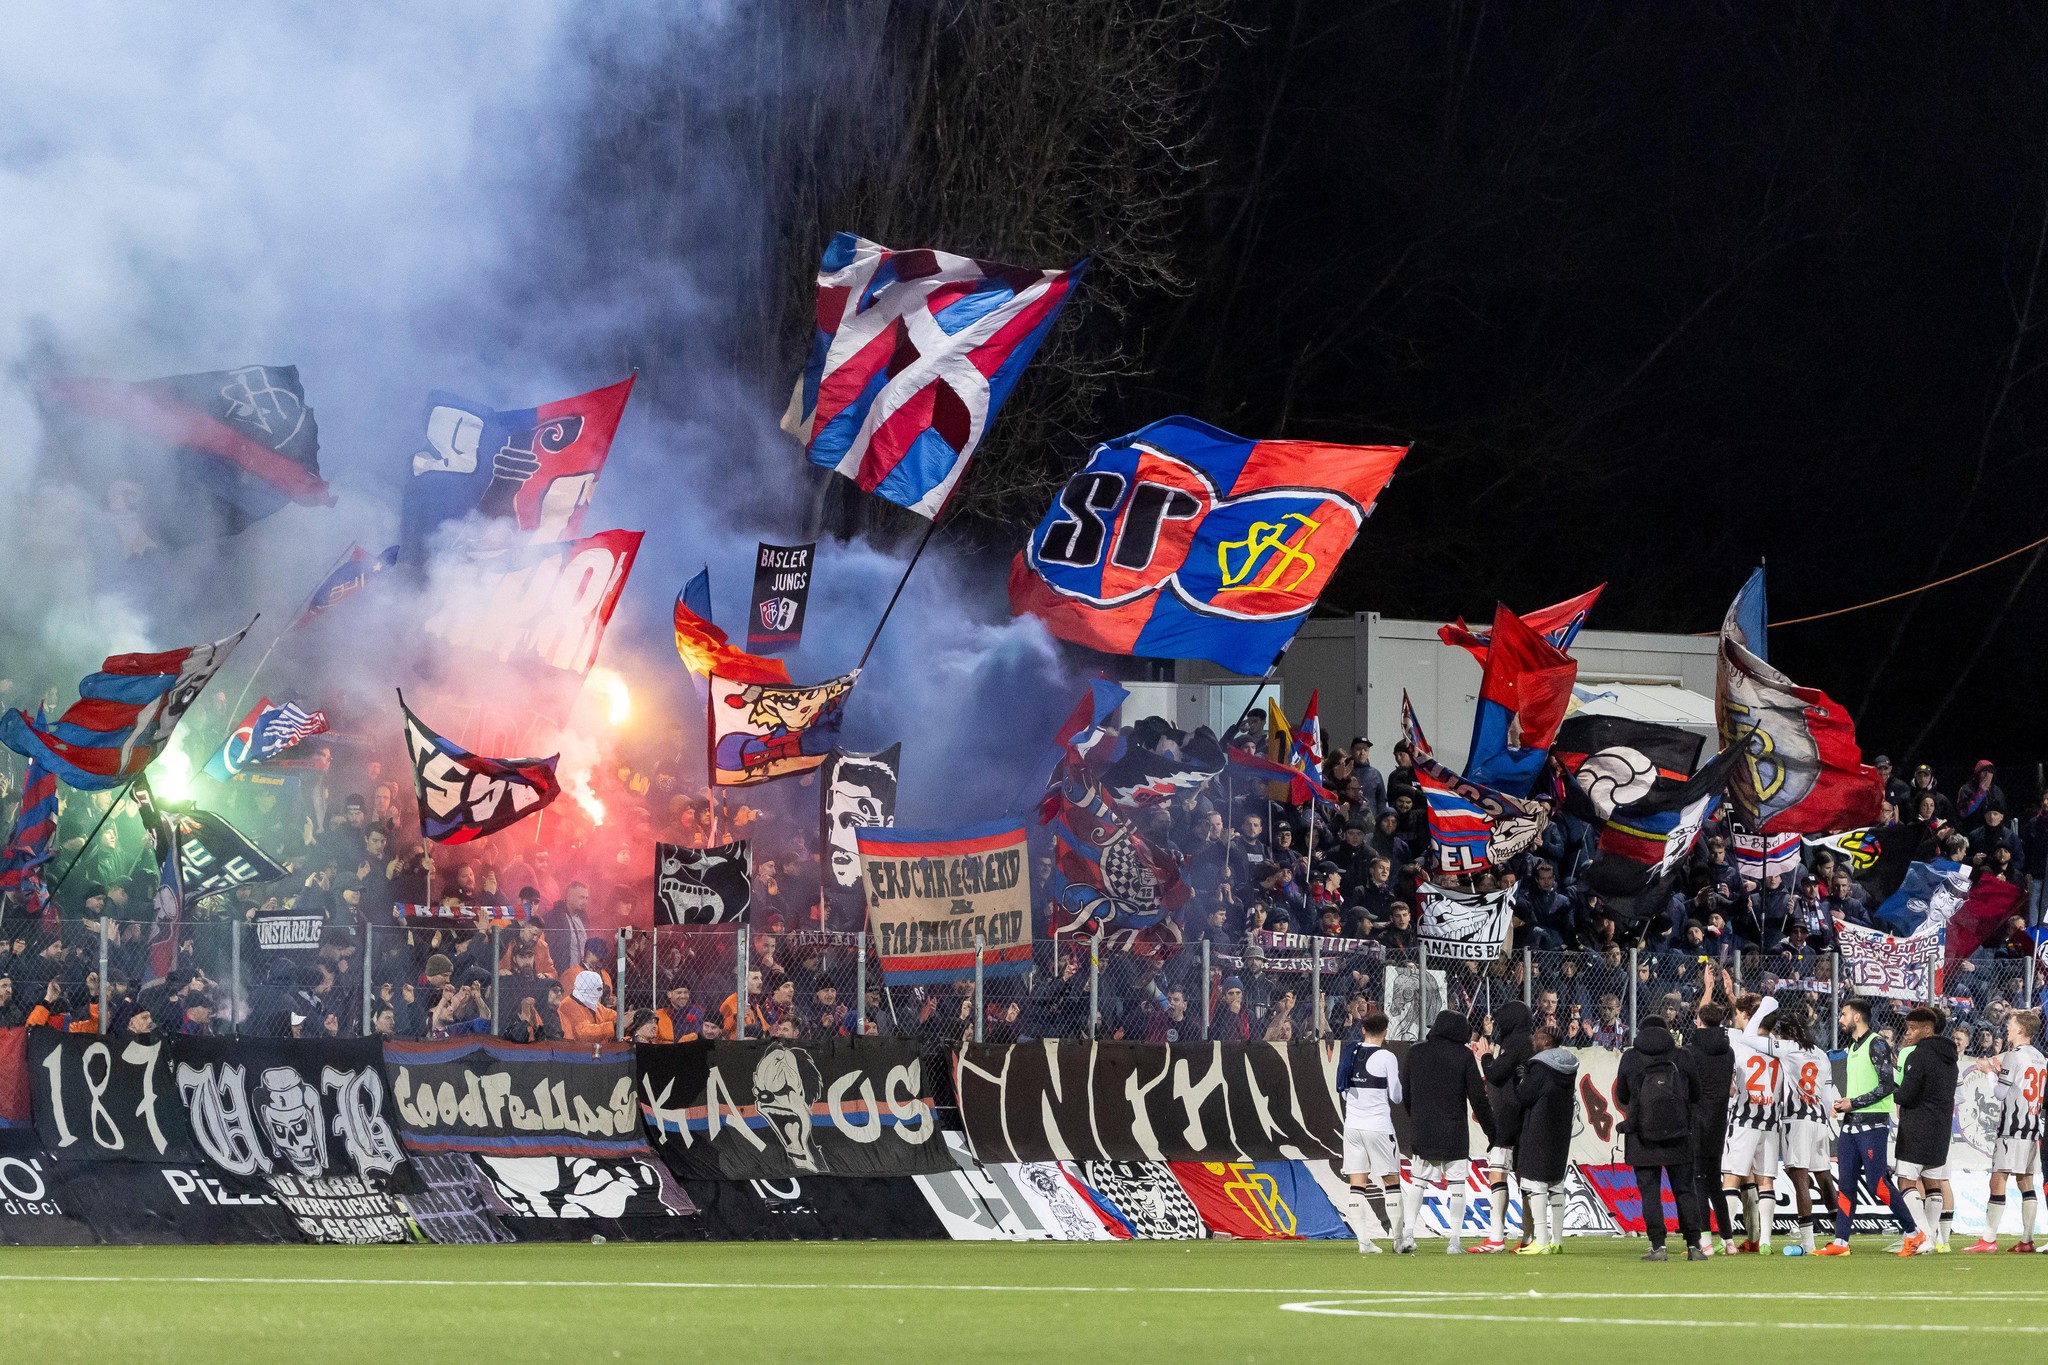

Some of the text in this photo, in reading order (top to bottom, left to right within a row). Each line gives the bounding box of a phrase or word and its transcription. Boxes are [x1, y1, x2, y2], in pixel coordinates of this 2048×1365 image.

[761, 549, 807, 568] BASLER
[772, 572, 807, 591] JUNGS
[1745, 1055, 1781, 1094] 21
[1798, 1061, 1819, 1096] 8
[2023, 1066, 2047, 1104] 30
[42, 1040, 169, 1156] 187
[4, 1198, 63, 1215] dieci
